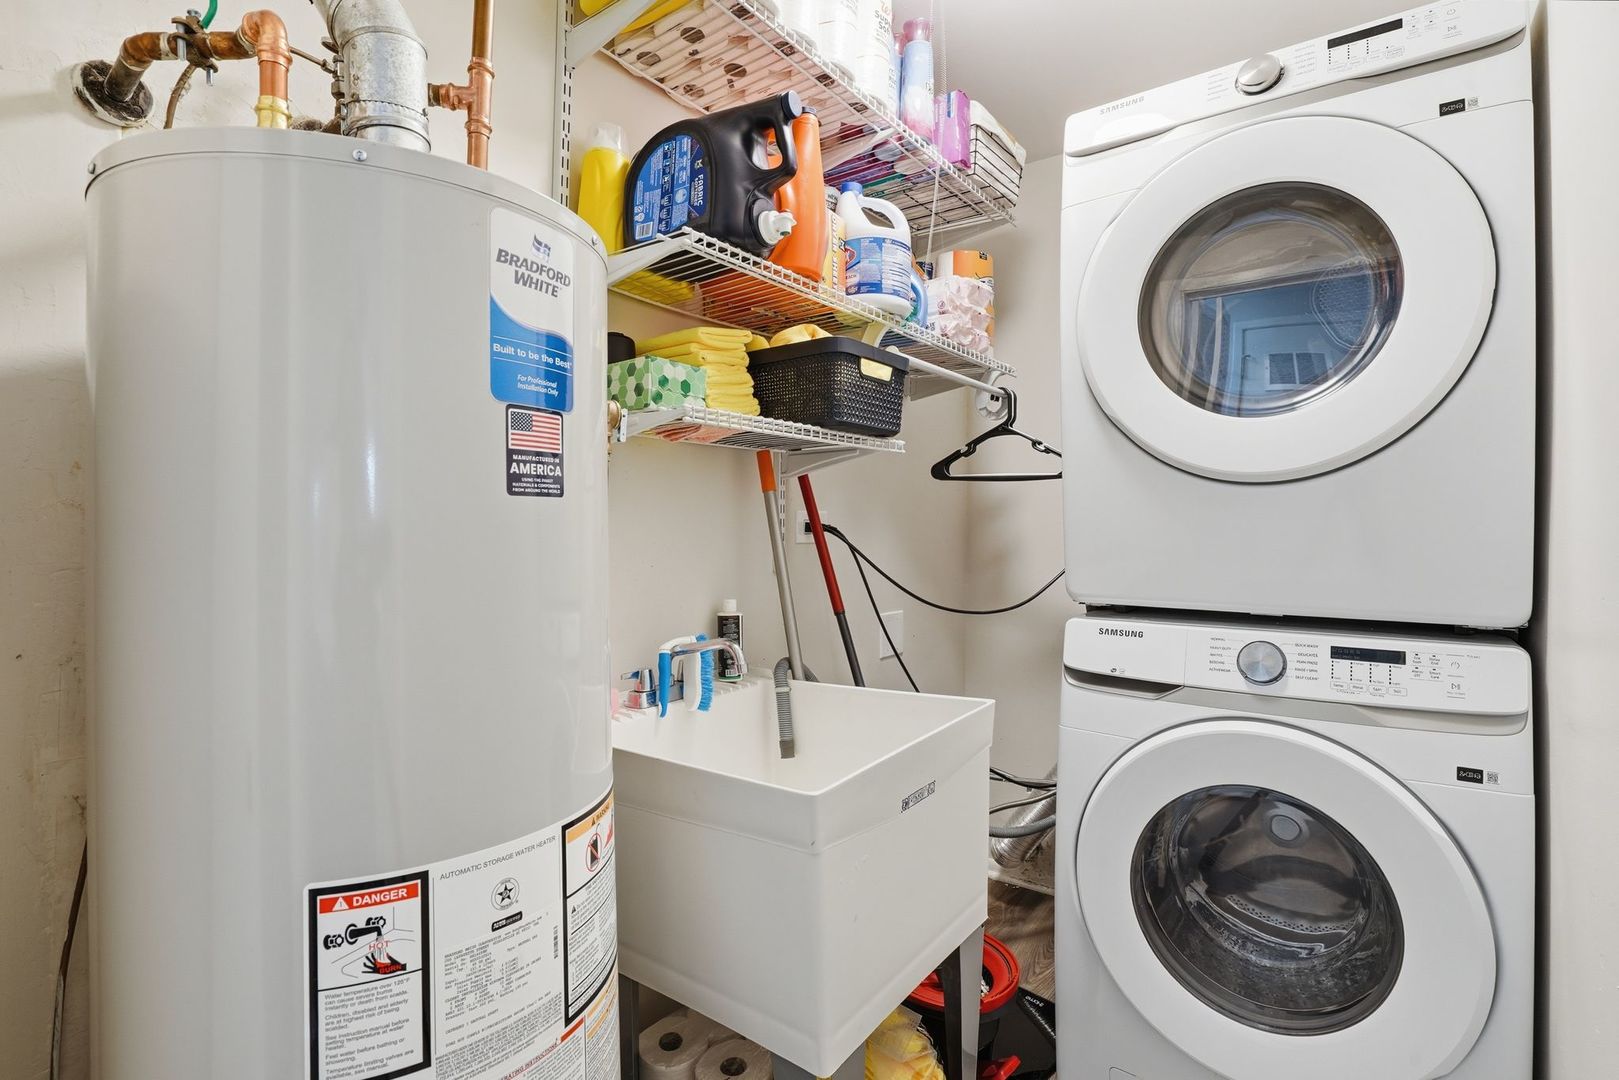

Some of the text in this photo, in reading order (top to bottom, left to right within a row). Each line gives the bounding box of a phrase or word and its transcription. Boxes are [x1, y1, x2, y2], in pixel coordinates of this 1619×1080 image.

[1100, 96, 1144, 115] SAMSUNG
[496, 248, 571, 287] BRADFORD
[514, 270, 558, 298] WHITE
[493, 344, 515, 355] Built
[517, 348, 526, 358] to
[528, 350, 540, 360] be
[542, 353, 554, 364] the
[528, 376, 557, 388] Professional
[518, 383, 558, 397] Installation Only
[512, 454, 553, 463] MANUFACTURED
[510, 462, 562, 477] AMERICA
[1098, 628, 1144, 638] SAMSUNG
[440, 836, 556, 880] AUTOMATIC STORAGE WATER HEATER
[352, 888, 408, 907] DANGER
[368, 940, 390, 951] HOT
[380, 964, 402, 974] BURN
